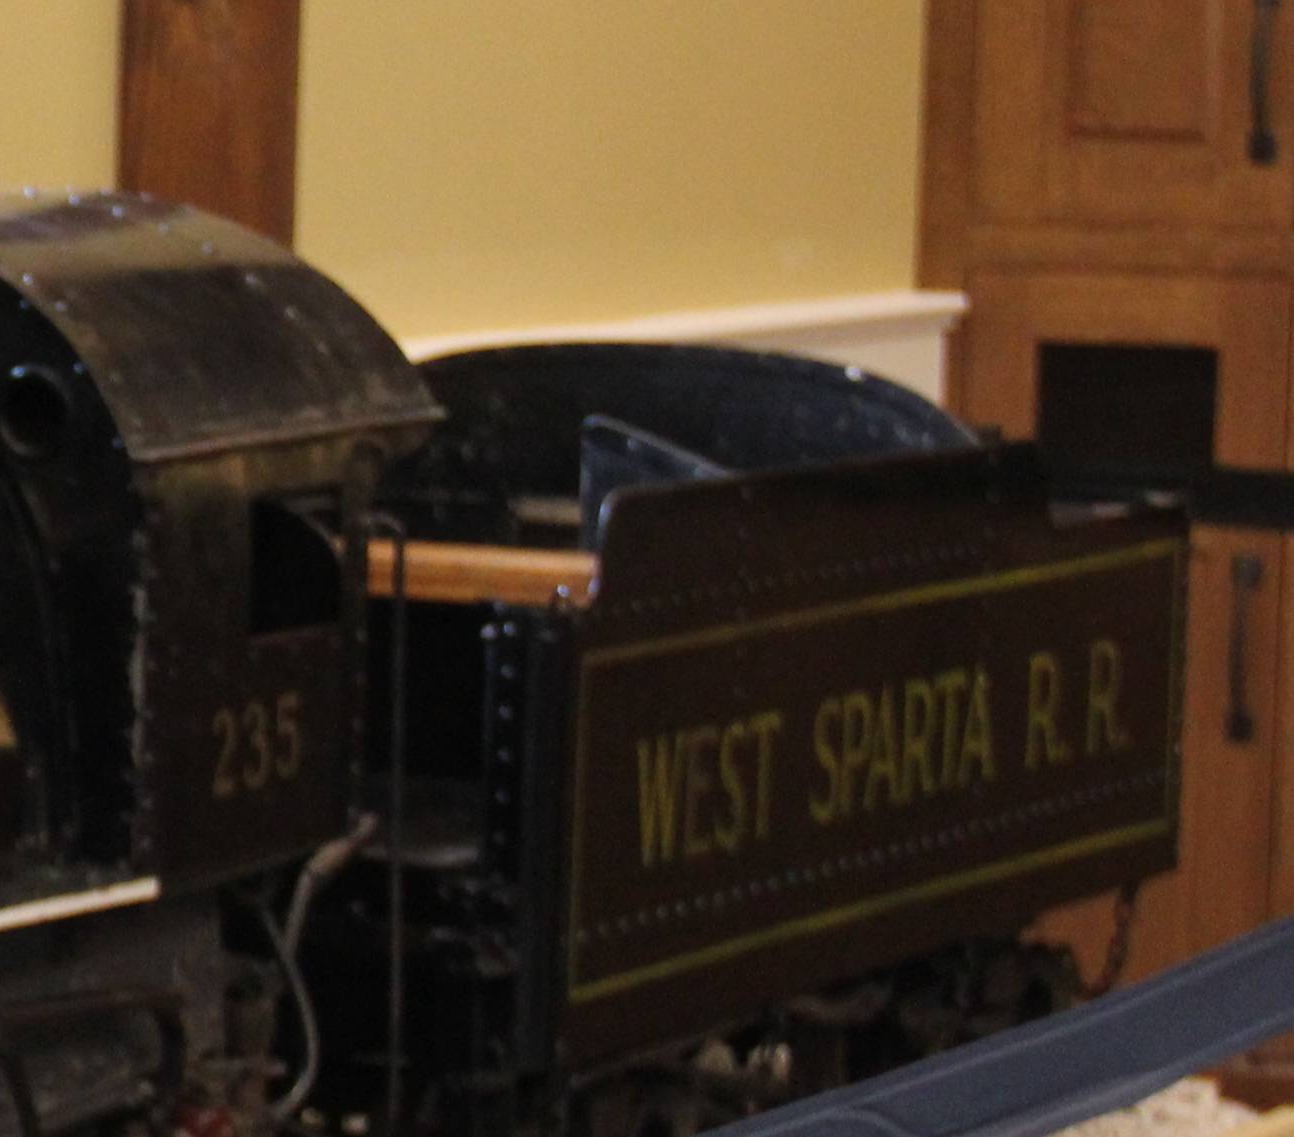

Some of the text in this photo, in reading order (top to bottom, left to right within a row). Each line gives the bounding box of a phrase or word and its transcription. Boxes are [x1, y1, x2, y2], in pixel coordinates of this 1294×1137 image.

[213, 690, 301, 797] 235
[637, 712, 782, 868] WEST
[810, 667, 996, 824] SPARTA
